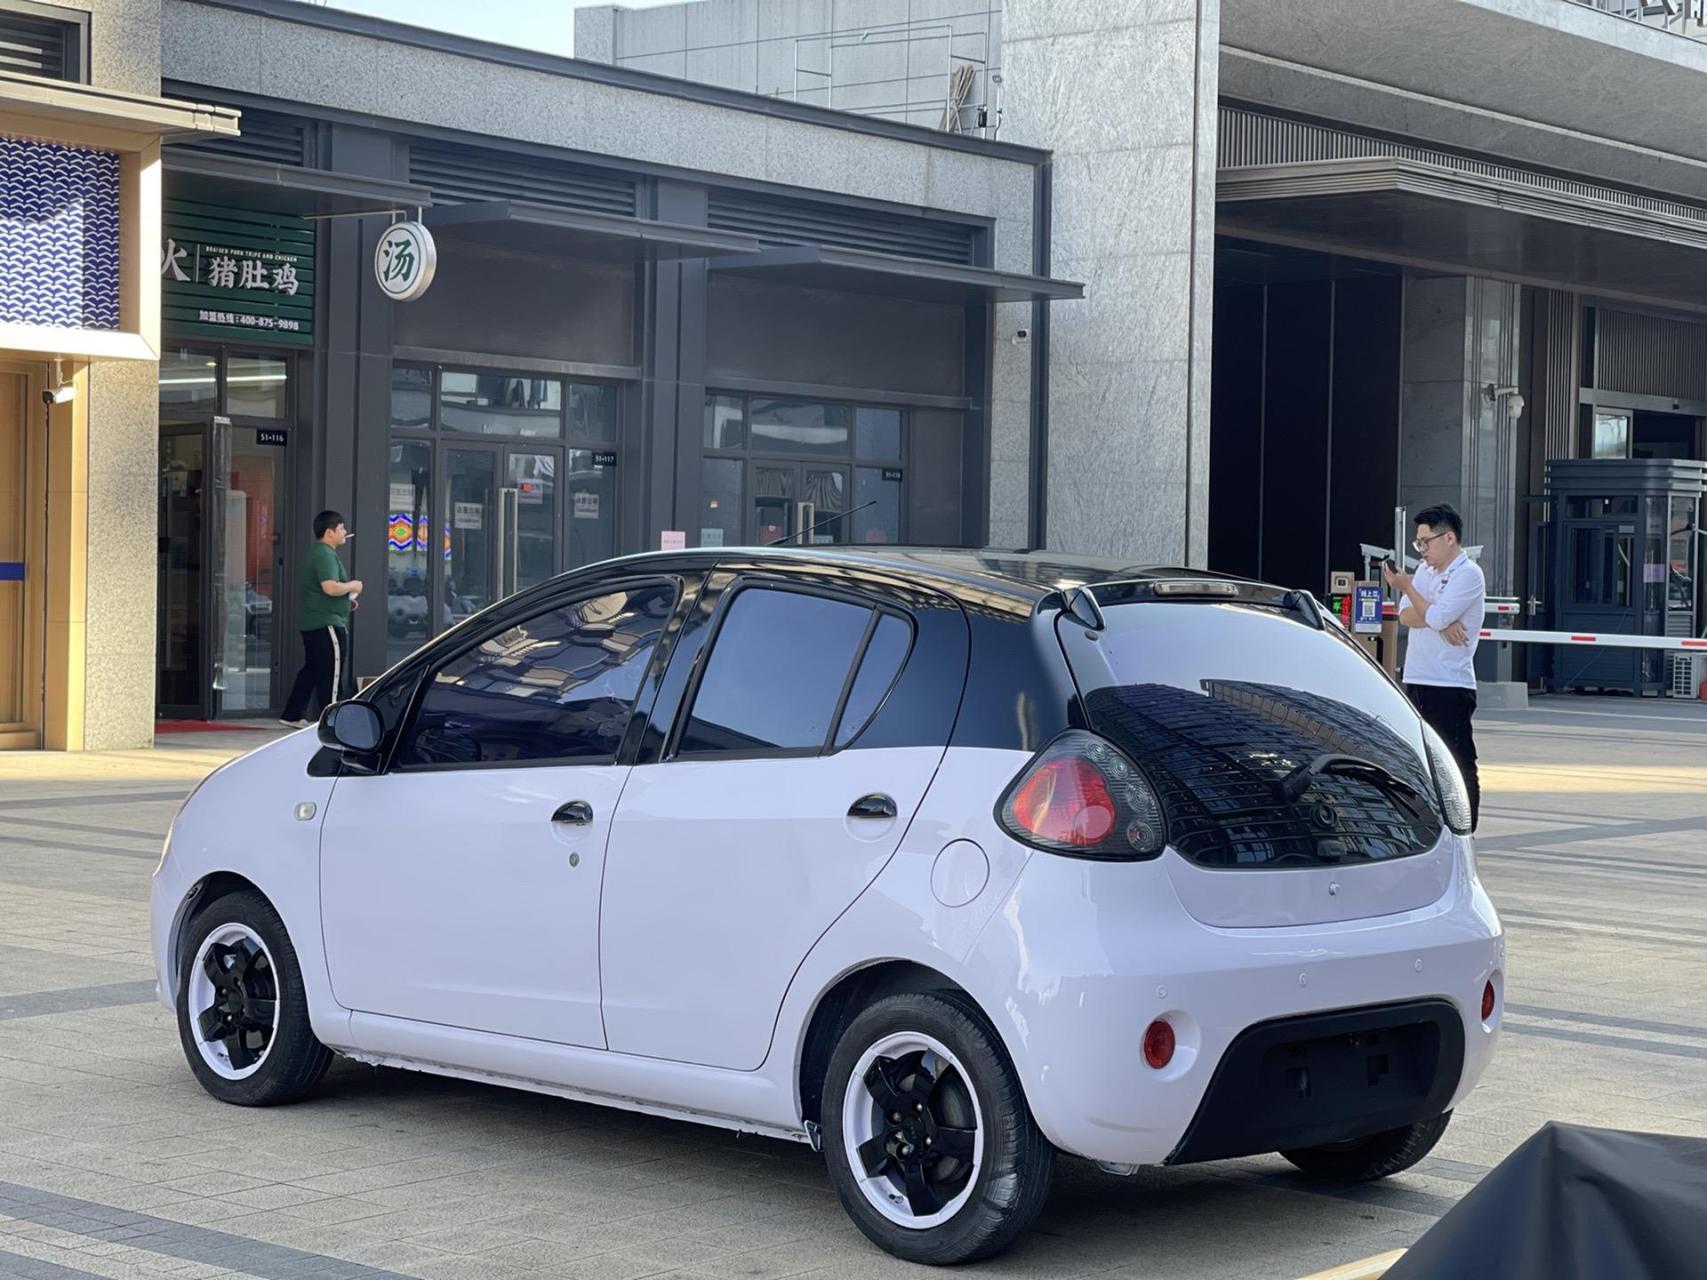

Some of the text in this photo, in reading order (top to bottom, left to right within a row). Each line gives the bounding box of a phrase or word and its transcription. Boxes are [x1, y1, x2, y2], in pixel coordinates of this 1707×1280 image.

[161, 238, 191, 281] 火
[208, 255, 299, 296] 猪肚鸡
[383, 238, 415, 282] 汤
